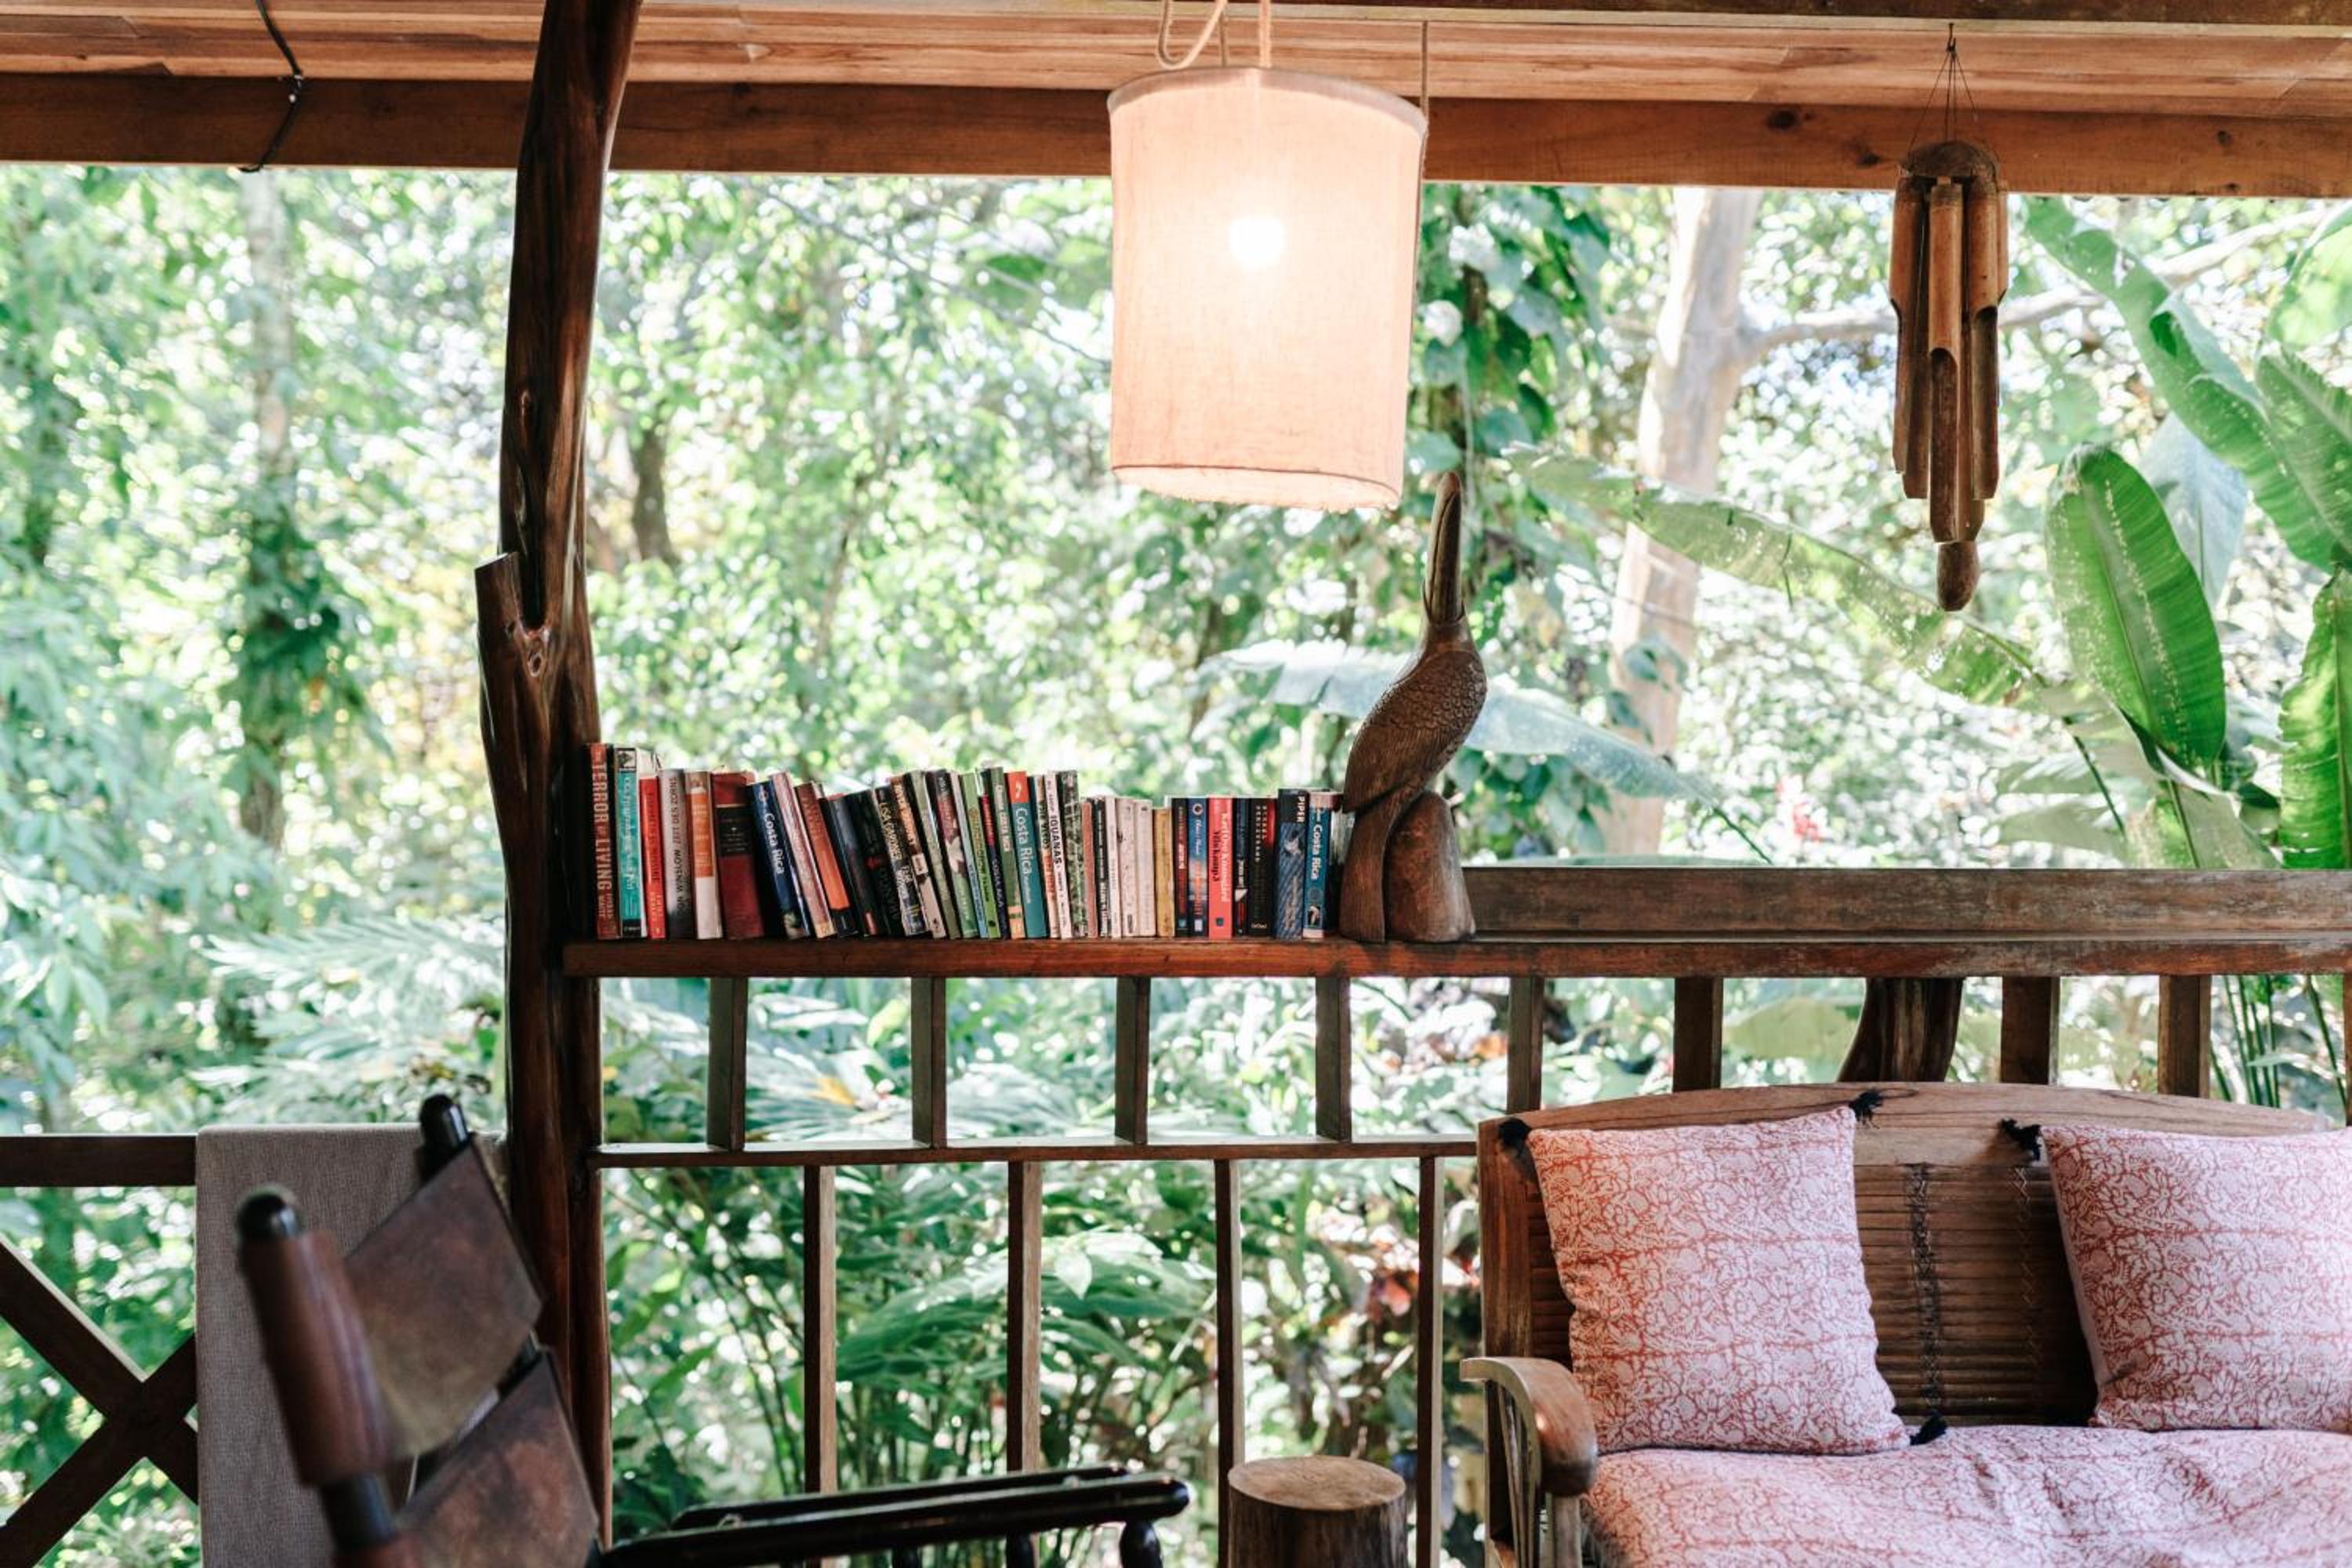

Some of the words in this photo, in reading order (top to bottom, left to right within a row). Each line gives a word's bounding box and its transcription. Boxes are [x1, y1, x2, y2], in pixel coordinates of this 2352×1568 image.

[593, 764, 608, 822] TERROR
[1296, 796, 1305, 822] PIPER
[879, 802, 889, 822] LISA
[884, 822, 902, 860] GARDNER
[1016, 808, 1029, 844] Costa
[1050, 815, 1062, 865] IGUANAS
[1221, 812, 1230, 833] Karl
[1312, 825, 1322, 855] Costa
[764, 814, 777, 847] Costa
[773, 850, 785, 873] Rica
[1020, 847, 1033, 875] Rica
[595, 838, 612, 890] LIVING
[673, 849, 683, 893] WINSLOW
[1311, 858, 1320, 879] Rica
